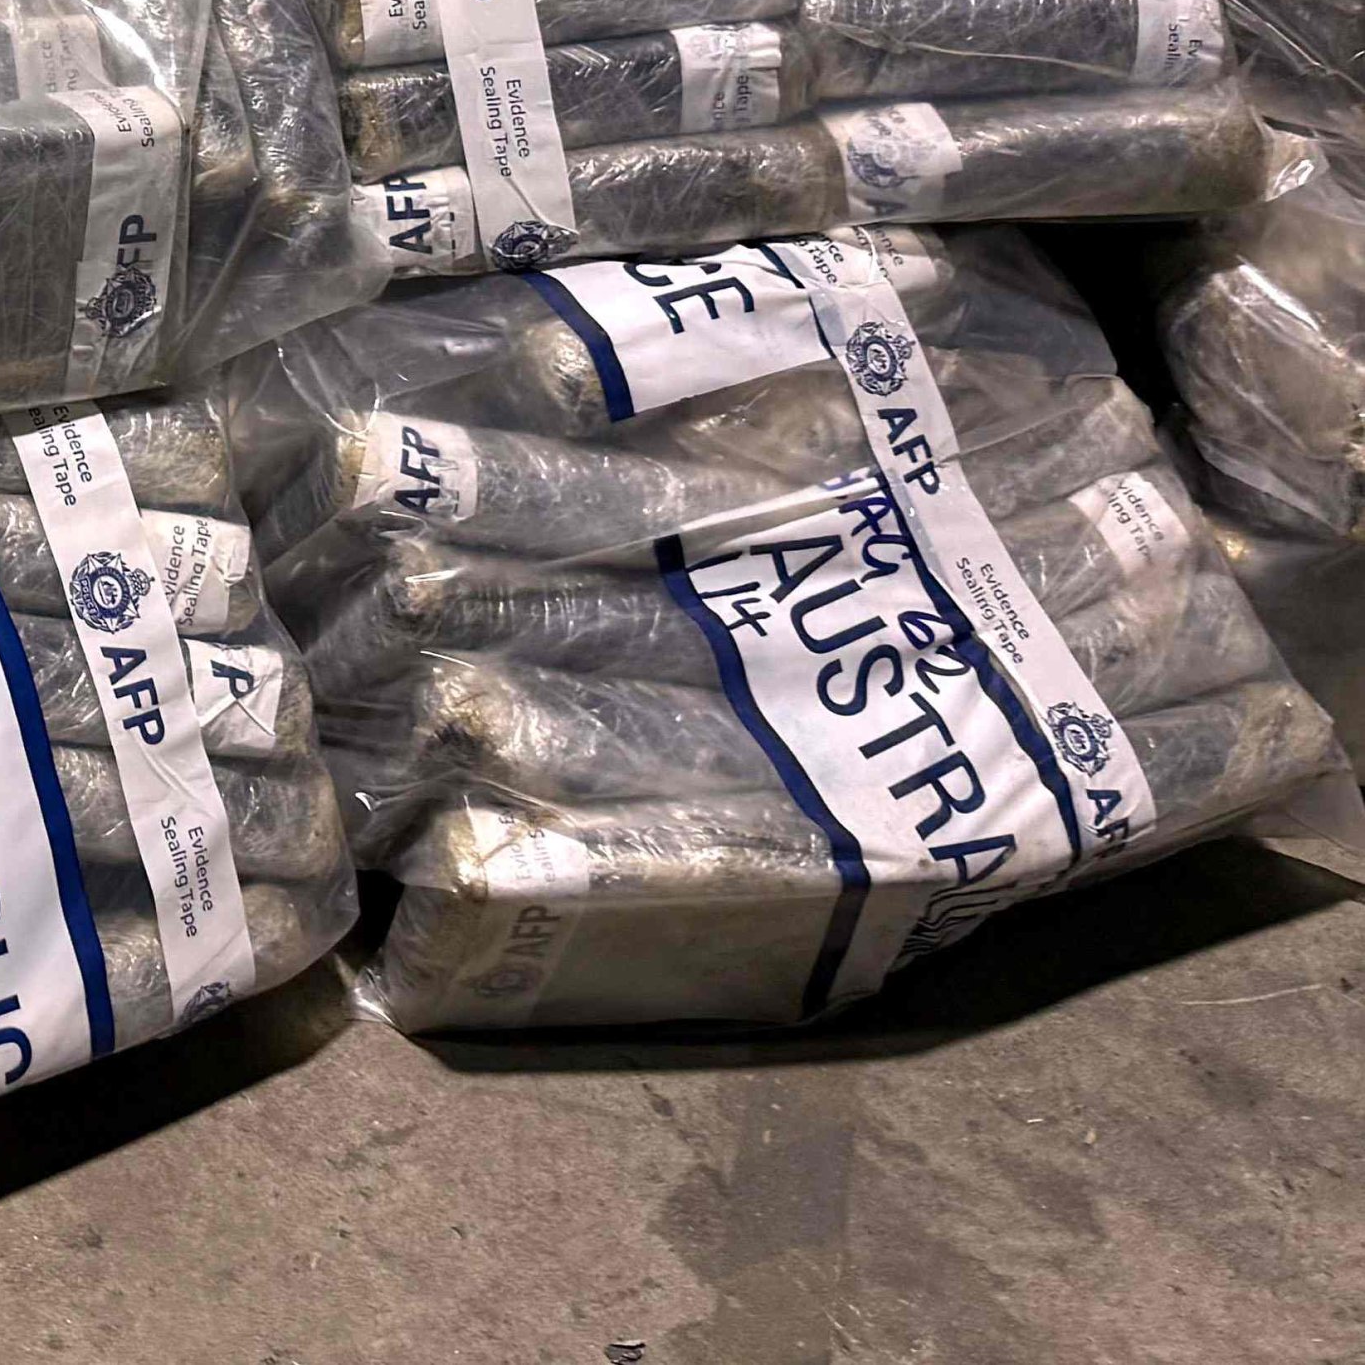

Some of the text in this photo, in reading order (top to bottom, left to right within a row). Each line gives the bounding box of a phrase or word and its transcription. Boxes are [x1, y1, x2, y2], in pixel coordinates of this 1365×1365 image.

[479, 66, 512, 179] Sealing Tape
[505, 77, 532, 159] Evidence
[28, 405, 77, 507] ealing Tape
[52, 404, 95, 483] Evidence
[393, 426, 443, 515] AFP
[876, 407, 942, 499] AFP
[178, 517, 211, 627] Sealing Tape
[955, 556, 1025, 666] Sealing Tape
[979, 561, 1032, 641] Evidence
[99, 644, 166, 746] AFP
[160, 815, 200, 938] Sealing Tape
[187, 825, 215, 911] Evidence
